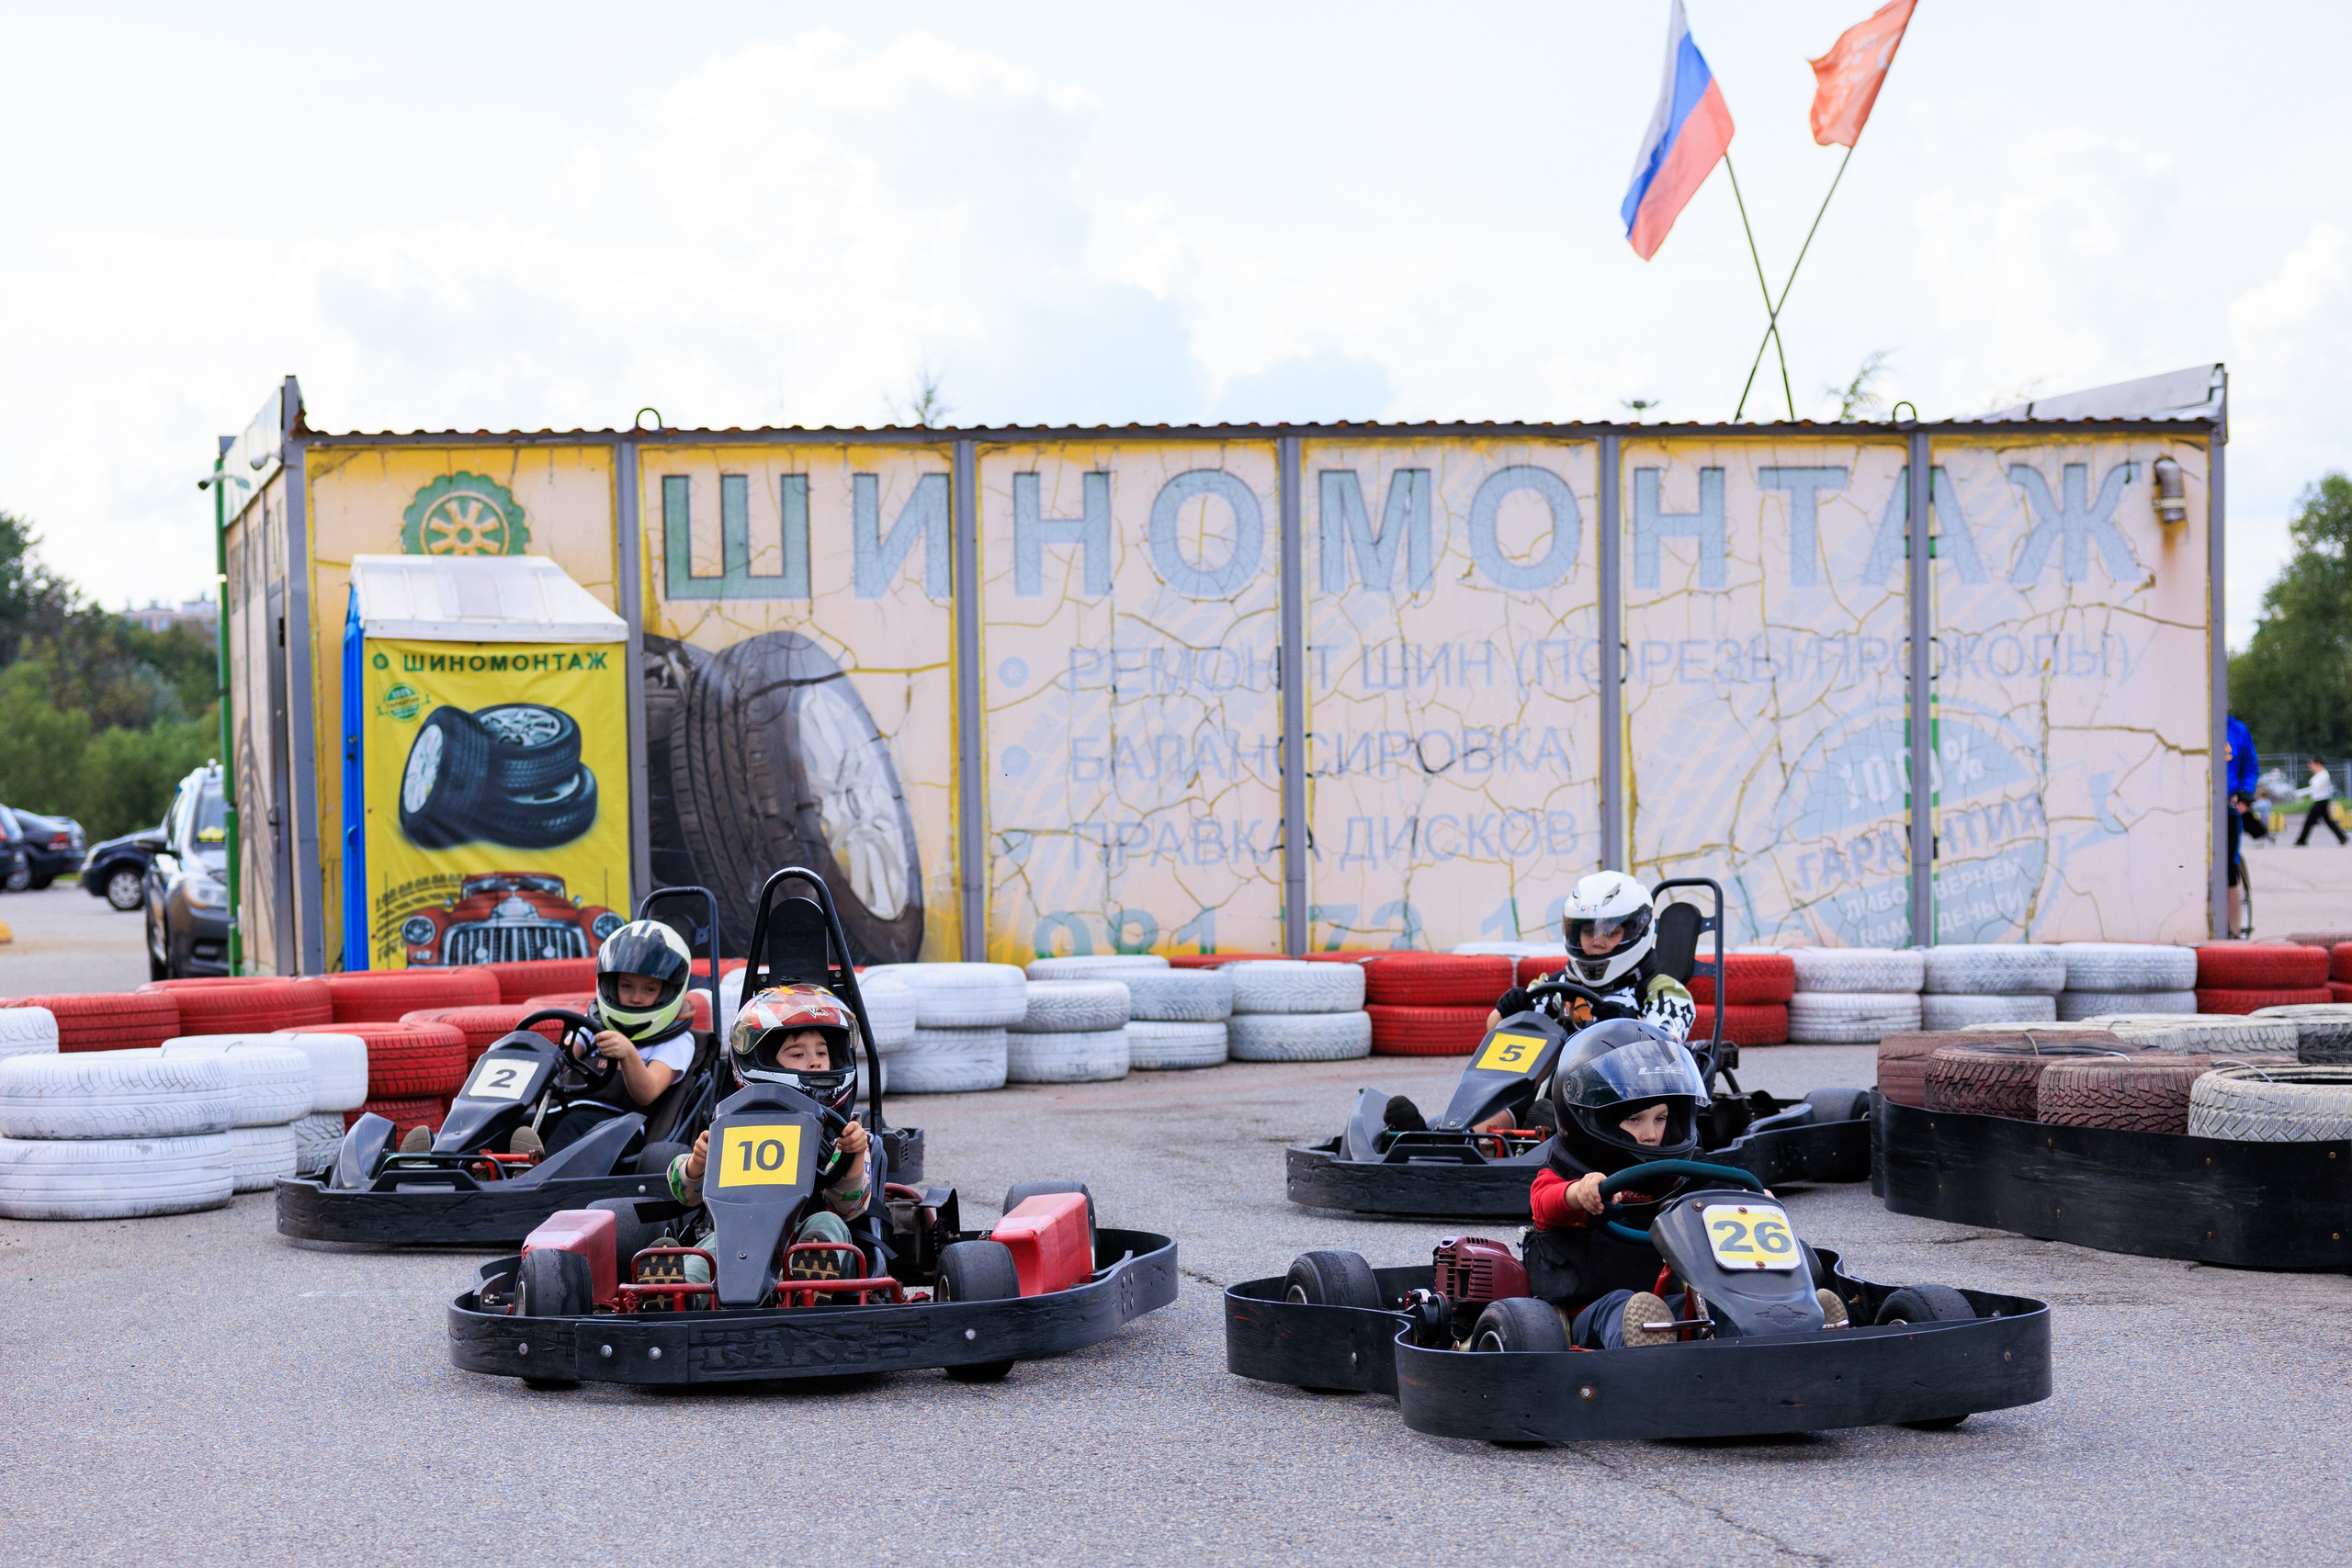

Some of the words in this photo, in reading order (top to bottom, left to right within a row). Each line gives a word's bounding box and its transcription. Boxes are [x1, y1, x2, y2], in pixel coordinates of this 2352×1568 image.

[661, 462, 2143, 601] ШИНОМОНТАЖ
[404, 652, 607, 671] ШИНОМОНТАЖ
[1069, 643, 1343, 695] РЕМОНТ
[1361, 641, 1493, 690] ШИН
[1071, 726, 1571, 783] БАЛАНСИРОВКА
[1073, 818, 1323, 871] ПРАВКА
[1340, 811, 1578, 872] ДИСКОВ
[1796, 791, 2046, 893] ГАРАНТИЯ
[1498, 1043, 1523, 1063] 5
[1637, 1066, 1685, 1076] LS2
[488, 1068, 517, 1089] 2
[737, 1139, 786, 1172] 10
[1712, 1219, 1793, 1255] 26
